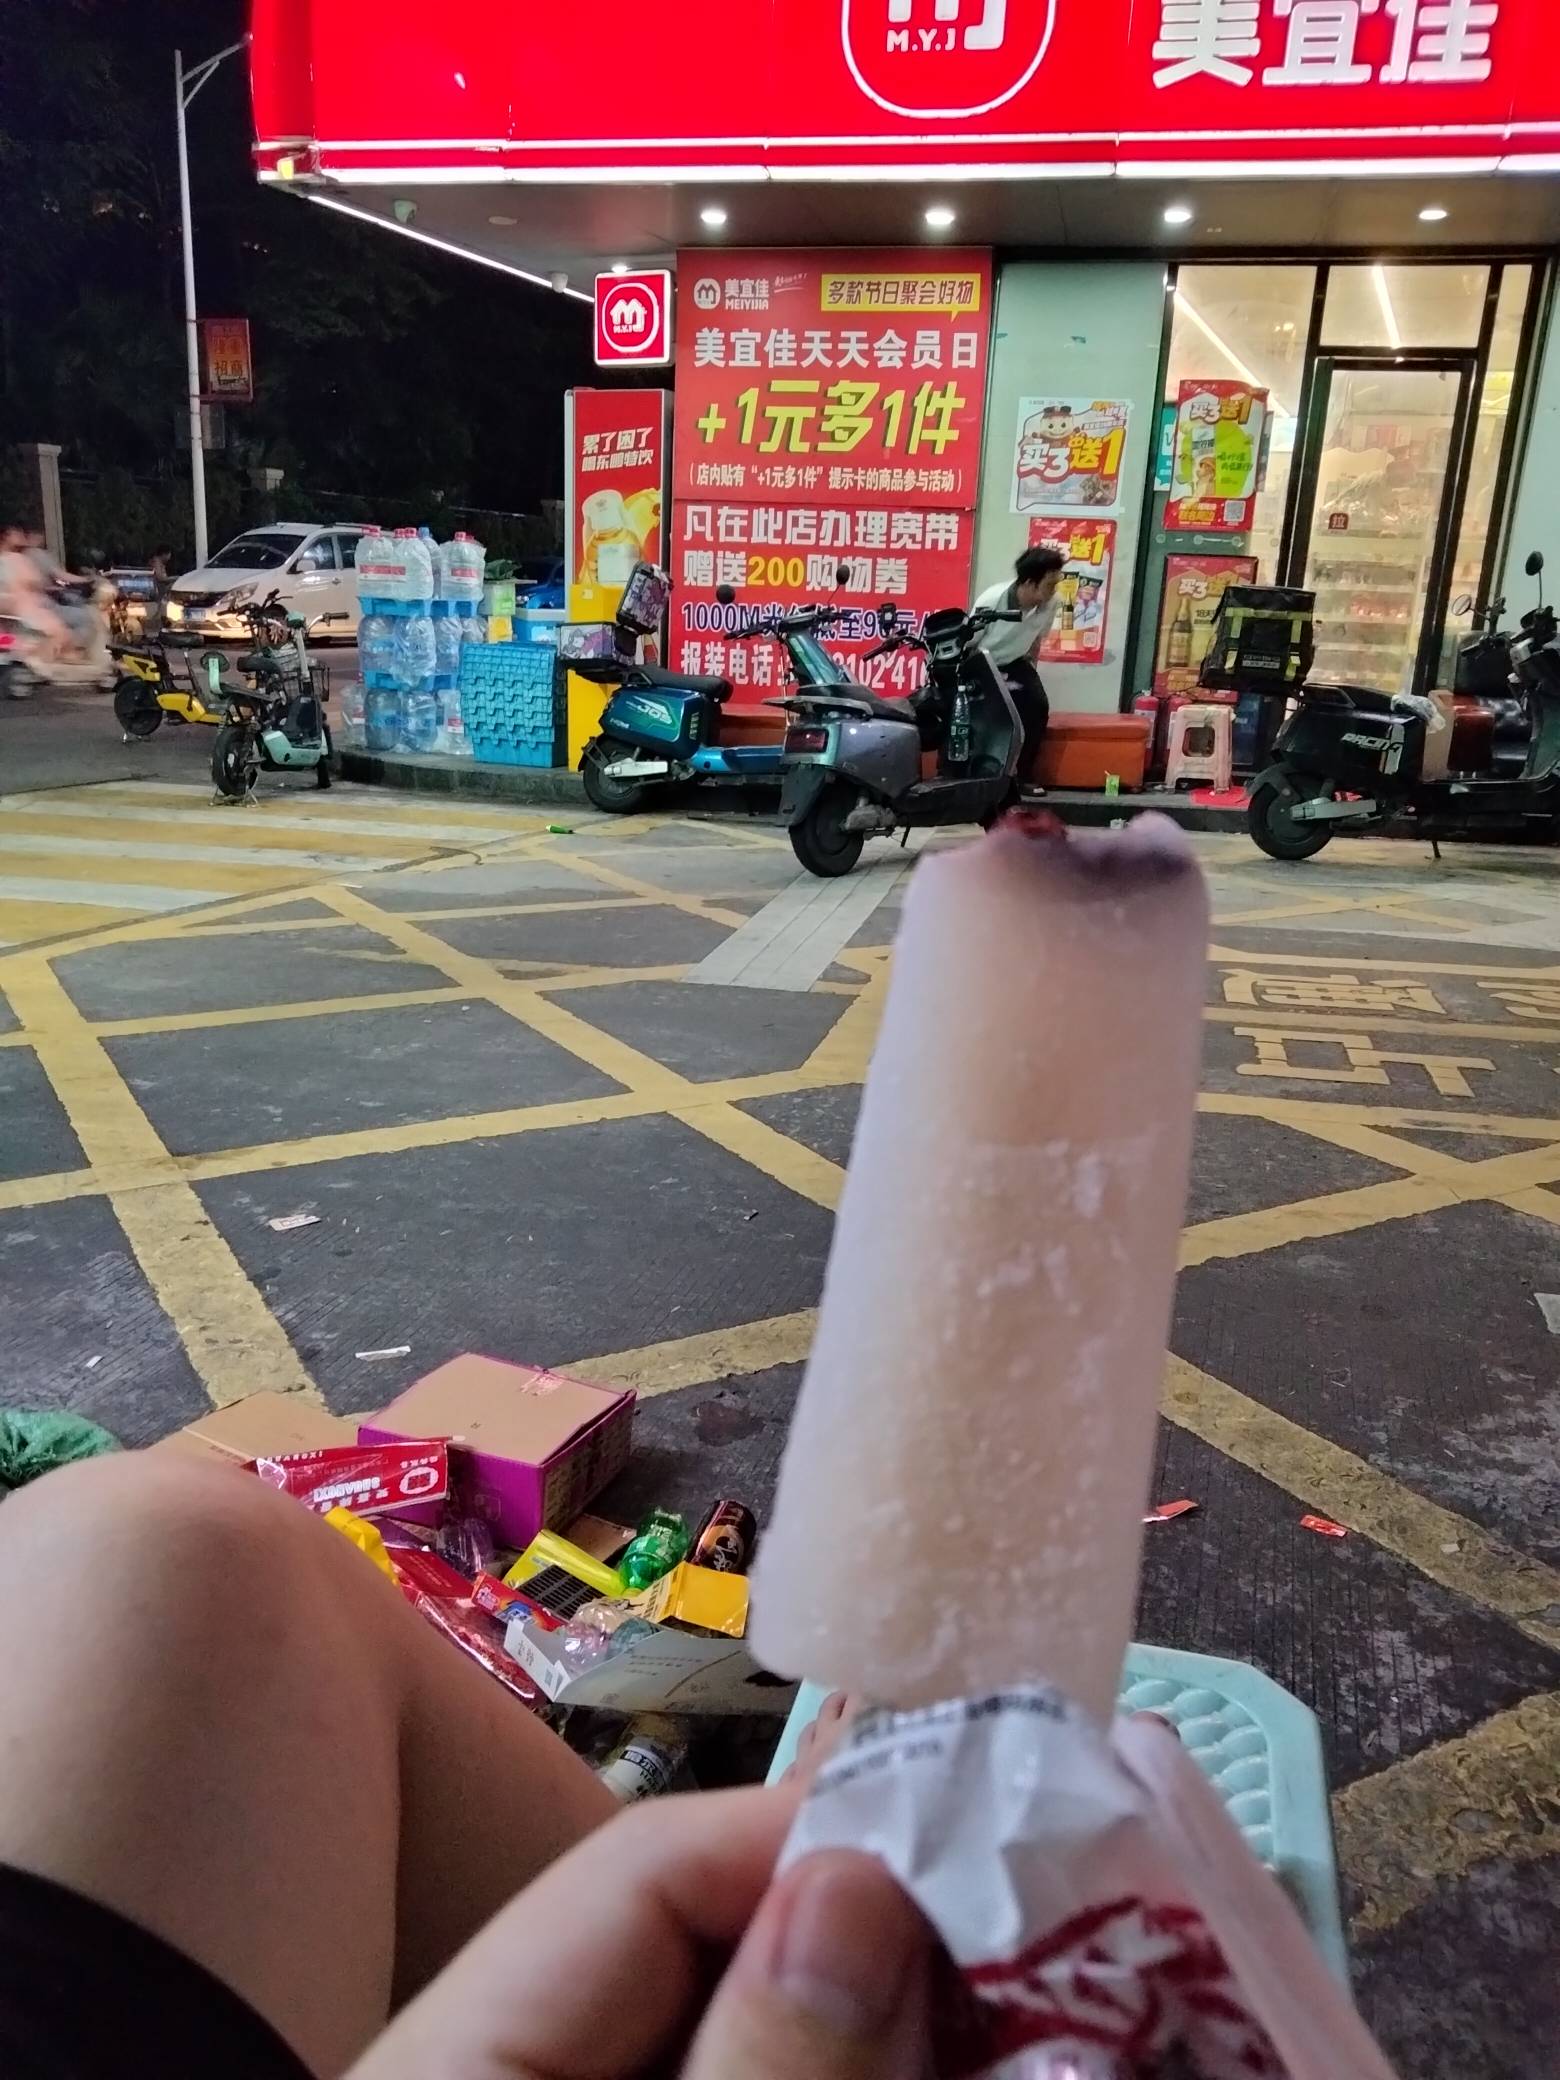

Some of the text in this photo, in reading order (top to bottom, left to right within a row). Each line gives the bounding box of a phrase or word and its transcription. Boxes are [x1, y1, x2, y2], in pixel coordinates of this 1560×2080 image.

[886, 28, 957, 53] M.Y.J
[1152, 0, 1499, 89] 美宜佳
[724, 278, 770, 298] 美宜佳
[724, 298, 769, 311] MEIYIJIA
[827, 279, 975, 305] 多款节日聚会好物
[693, 327, 979, 369] 美宜佳天天会员日
[697, 379, 966, 455] +1元多1件
[683, 504, 960, 551] 凡在此店办理宽带
